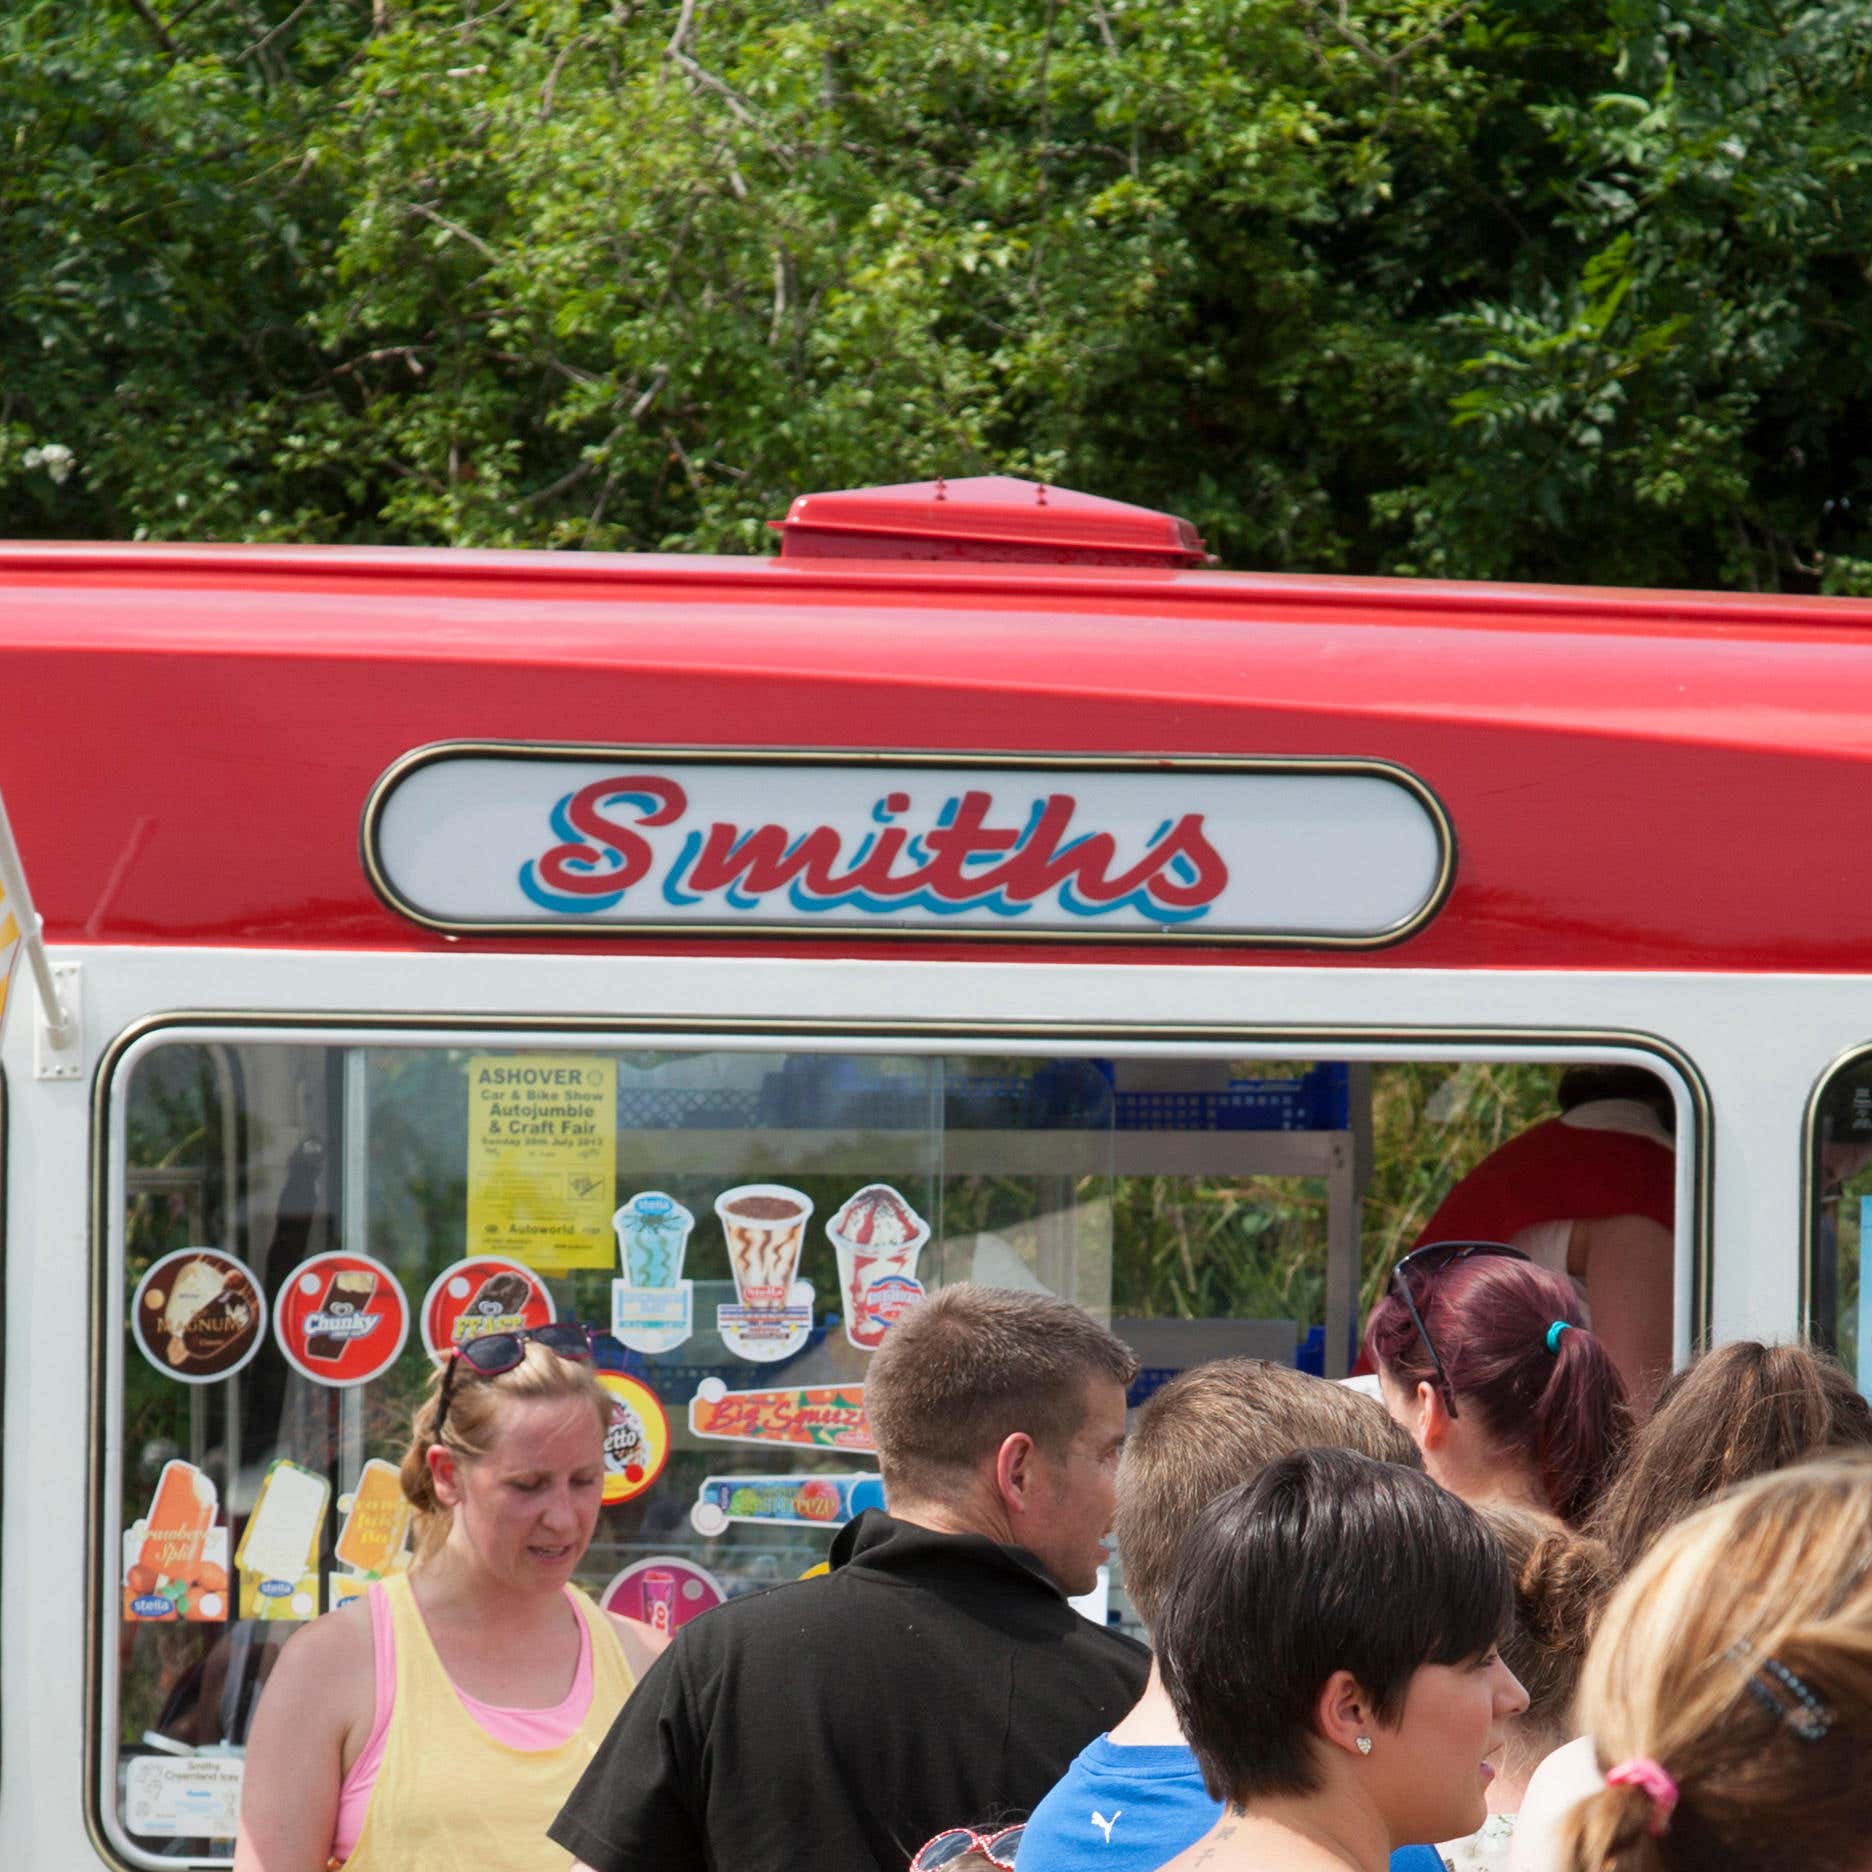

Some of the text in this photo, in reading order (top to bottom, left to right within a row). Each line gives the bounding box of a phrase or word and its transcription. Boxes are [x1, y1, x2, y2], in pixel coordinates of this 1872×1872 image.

[519, 774, 1230, 924] Smiths
[479, 1068, 582, 1085] ASHOVER
[481, 1089, 604, 1102] Car & Bike Show
[490, 1103, 595, 1119] Autojumble
[489, 1120, 596, 1134] & Craft Fair
[304, 1313, 378, 1336] Chunky
